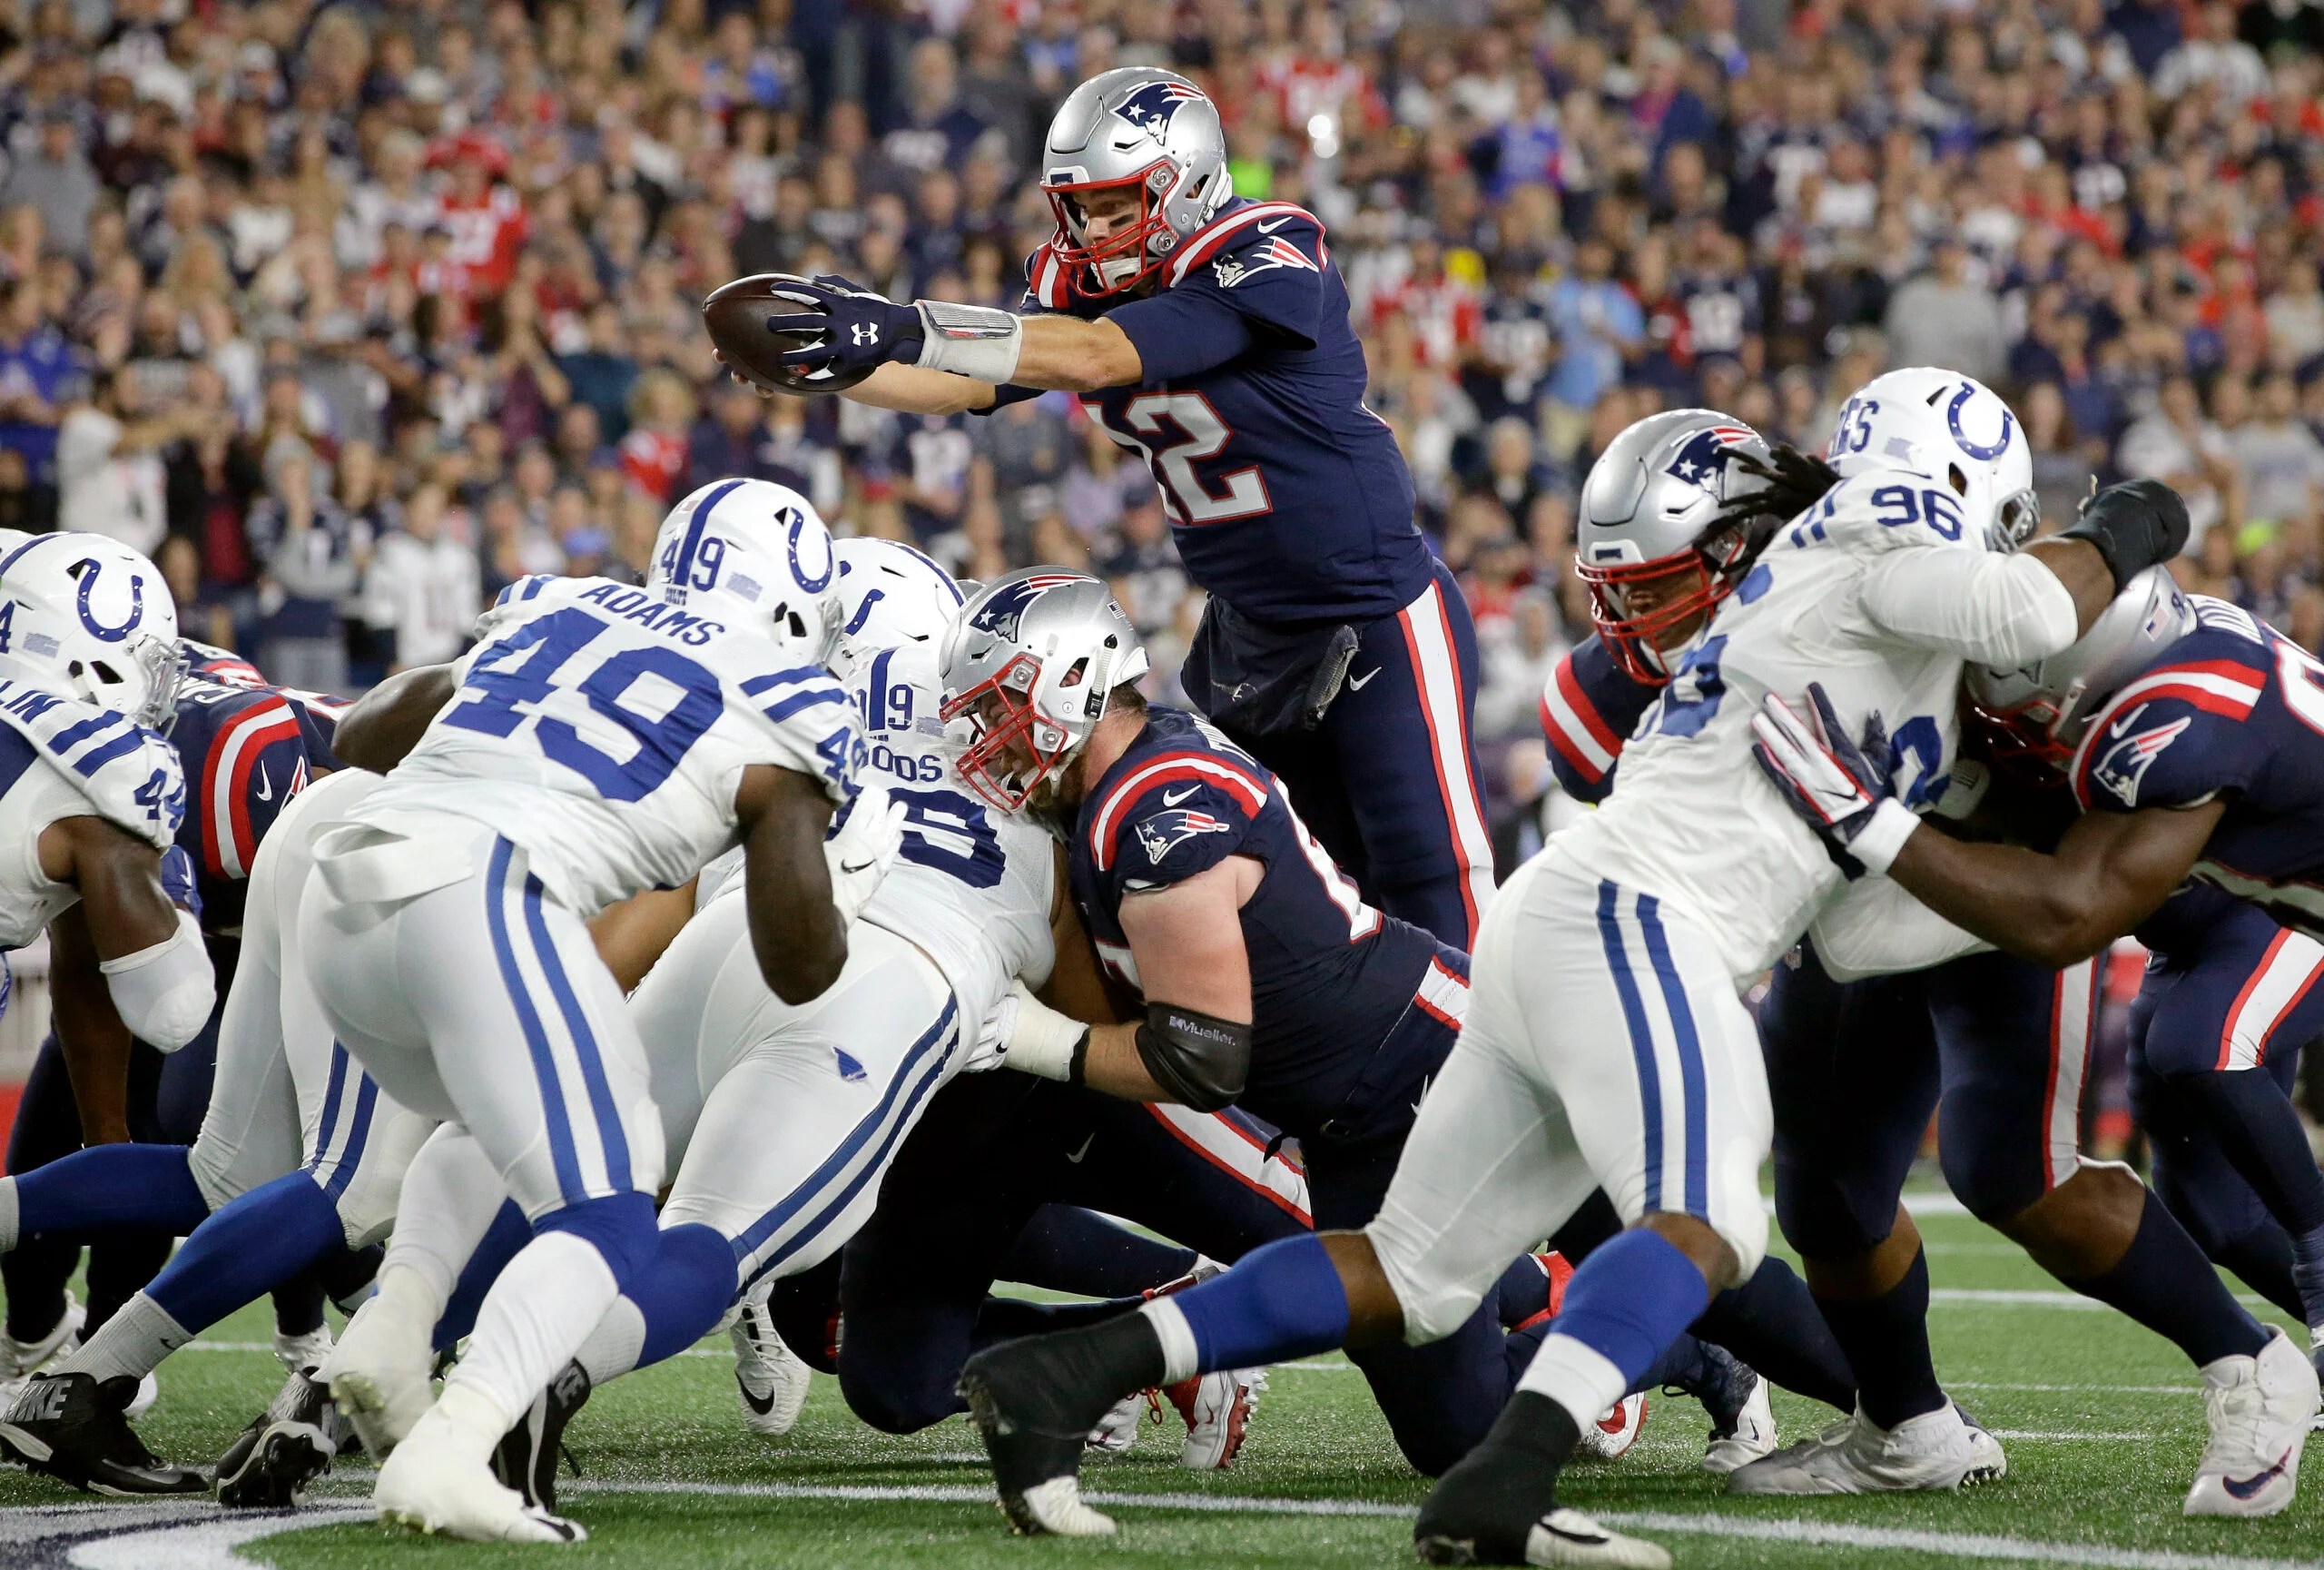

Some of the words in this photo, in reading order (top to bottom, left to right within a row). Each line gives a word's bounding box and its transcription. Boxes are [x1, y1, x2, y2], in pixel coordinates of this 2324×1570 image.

[1871, 485, 1965, 541] 96
[661, 537, 725, 592] 49
[576, 584, 725, 646] ADAMS
[440, 606, 724, 803] 49
